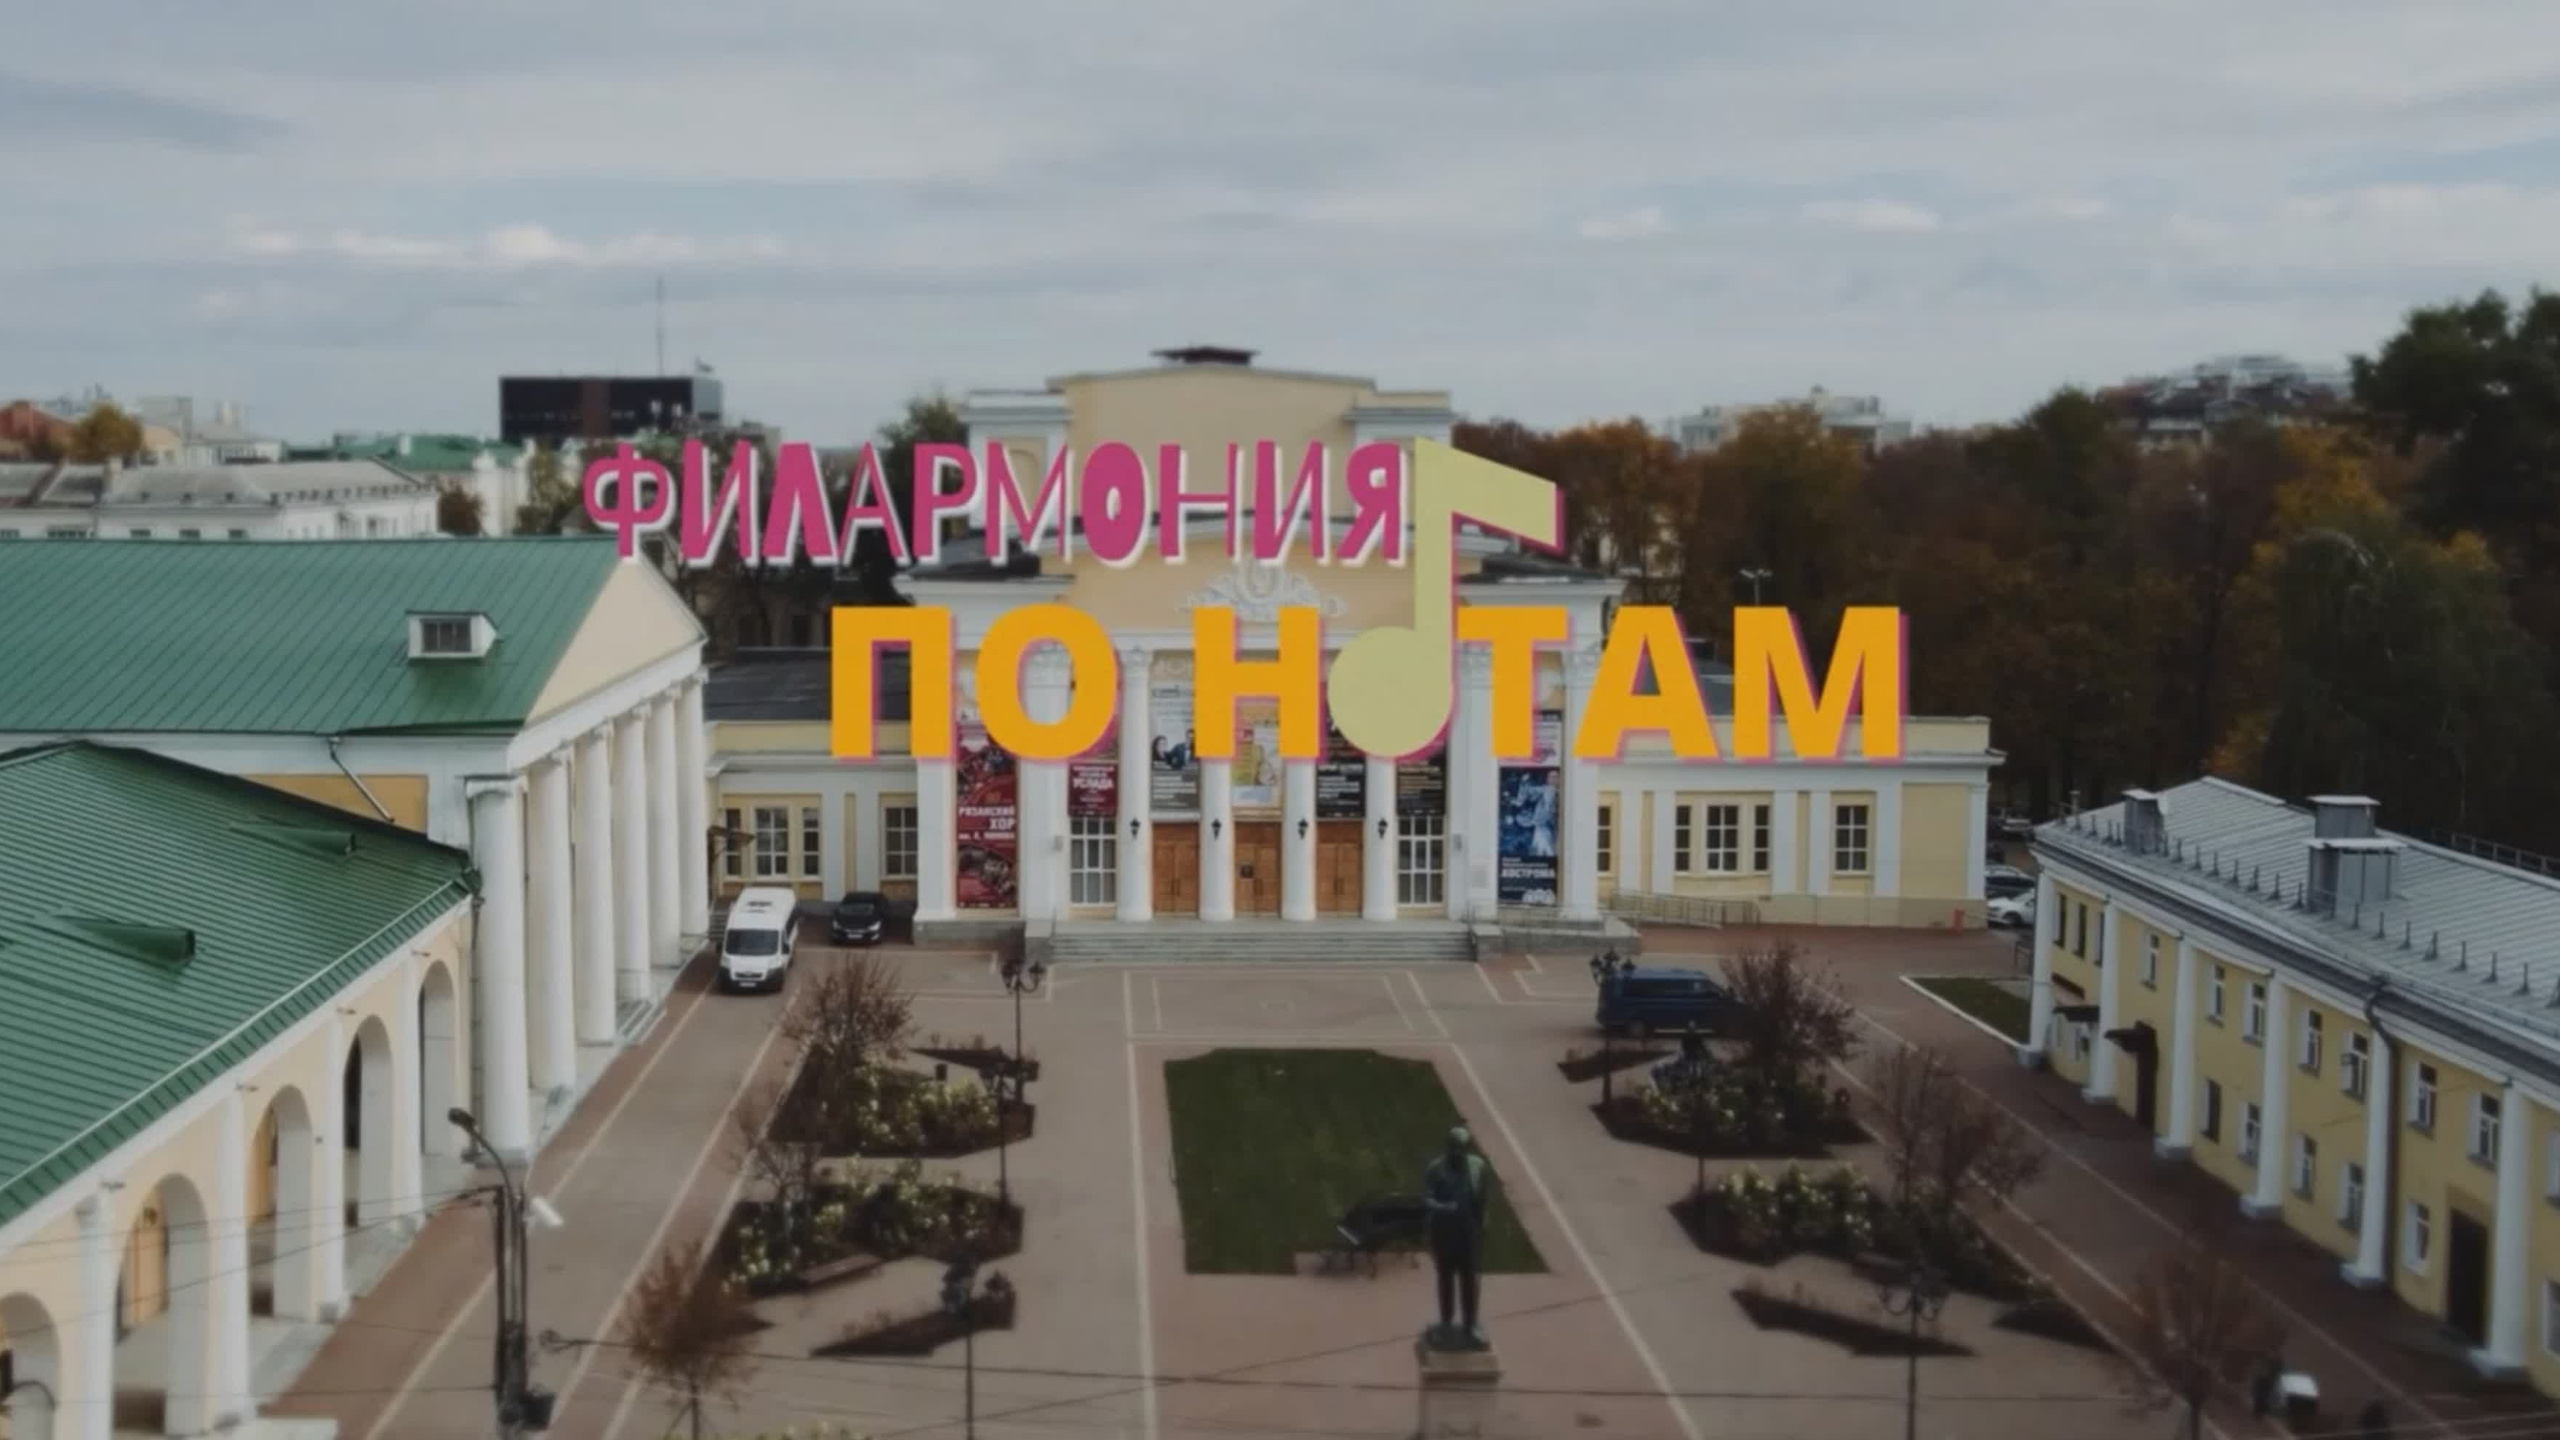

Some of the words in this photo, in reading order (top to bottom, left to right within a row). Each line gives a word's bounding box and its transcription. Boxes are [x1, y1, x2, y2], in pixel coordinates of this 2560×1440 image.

[958, 805, 1016, 818] РЯЗАНСКИЙ
[988, 818, 1016, 830] ХОР
[1501, 868, 1556, 878] КОСТРОМА
